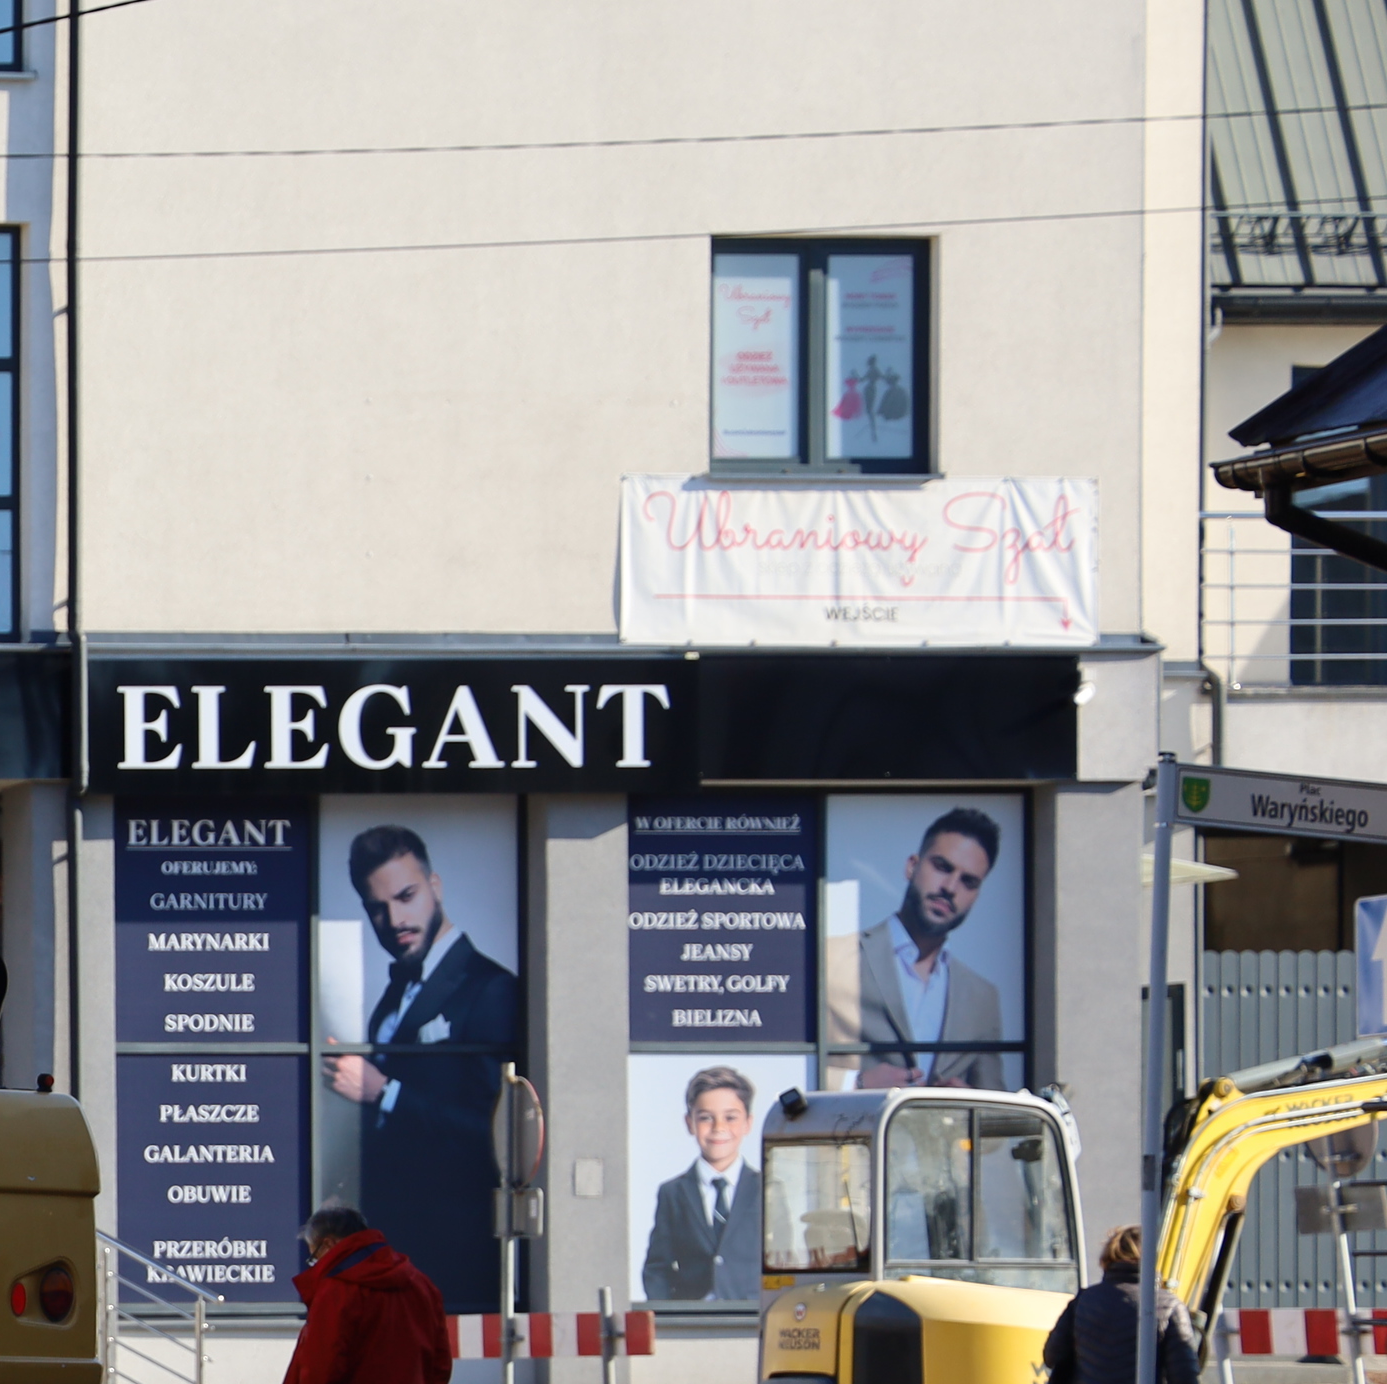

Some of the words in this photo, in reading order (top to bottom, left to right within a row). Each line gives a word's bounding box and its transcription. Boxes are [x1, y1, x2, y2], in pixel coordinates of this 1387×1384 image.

[643, 490, 928, 588] Ubraniowy
[825, 603, 900, 623] WEJŚCIE
[117, 684, 670, 770] ELEGANT
[1299, 782, 1322, 797] Plac
[634, 816, 652, 831] W
[653, 816, 723, 831] OFERCIE
[726, 813, 801, 831] RÓWNIEŻ
[1251, 793, 1369, 833] Waryńskiego
[127, 818, 291, 847] ELEGANT
[160, 860, 258, 875] OFERUJEMY:
[629, 850, 700, 872] ODZIEŻ
[702, 853, 805, 877] DZIECIĘCA
[659, 877, 776, 896] ELEGANCKA
[149, 892, 268, 911] GARNITURY
[628, 908, 700, 931] ODZIEŻ
[701, 911, 807, 930] SPORTOWA
[147, 932, 270, 952] MARYNARKI
[680, 943, 753, 962] JEANSY
[163, 973, 255, 993] KOSZULE
[643, 974, 725, 995] SWETRY,
[726, 974, 790, 993] GOLFY
[163, 1013, 255, 1033] SPODNIE
[672, 1008, 763, 1028] BIELIZNA
[170, 1063, 247, 1083] KURTKI
[158, 1104, 260, 1123] PŁASZCZE
[143, 1144, 275, 1164] GALANTERIA
[167, 1184, 252, 1204] OBUWIE
[153, 1236, 267, 1259] PRZERÓBKI
